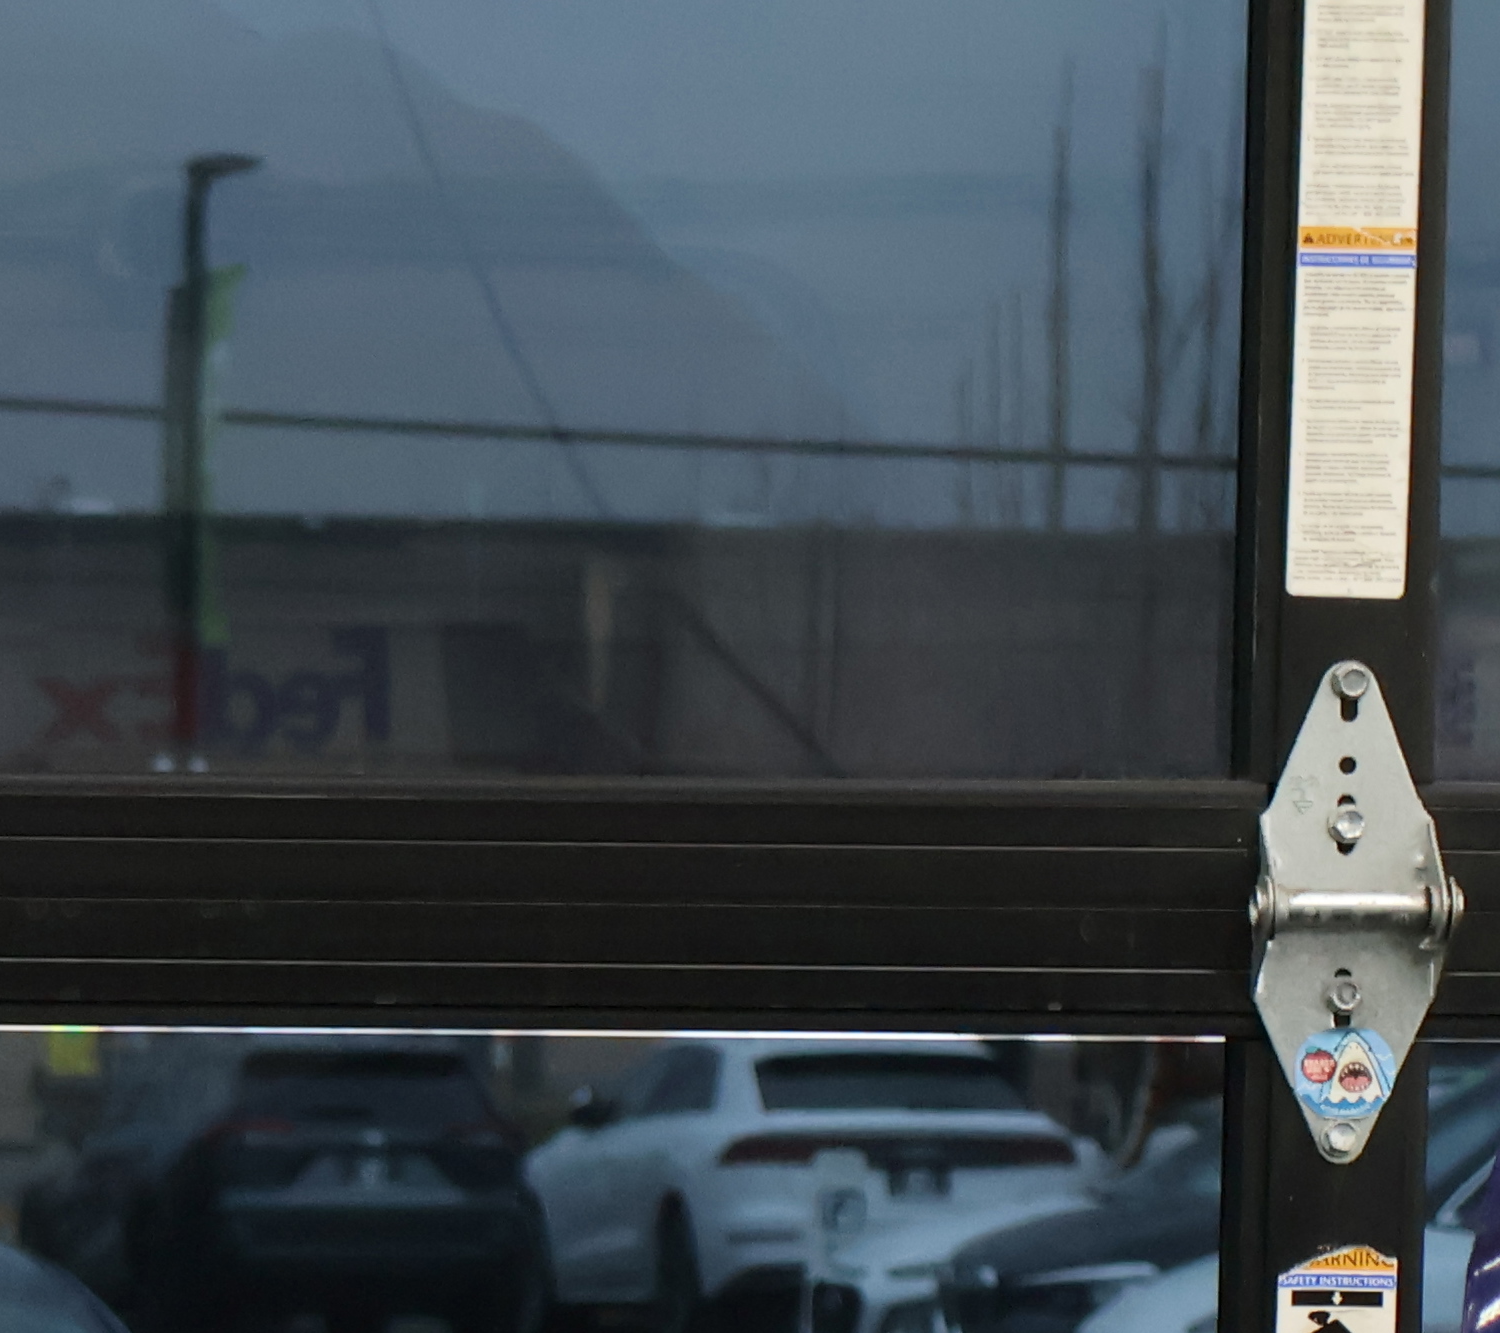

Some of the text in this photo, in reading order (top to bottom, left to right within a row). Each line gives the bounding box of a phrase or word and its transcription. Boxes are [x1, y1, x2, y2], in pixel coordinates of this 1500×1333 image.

[1310, 1247, 1395, 1268] ARNIN
[1280, 1275, 1394, 1288] SAFETY INSTRUCTIONS
